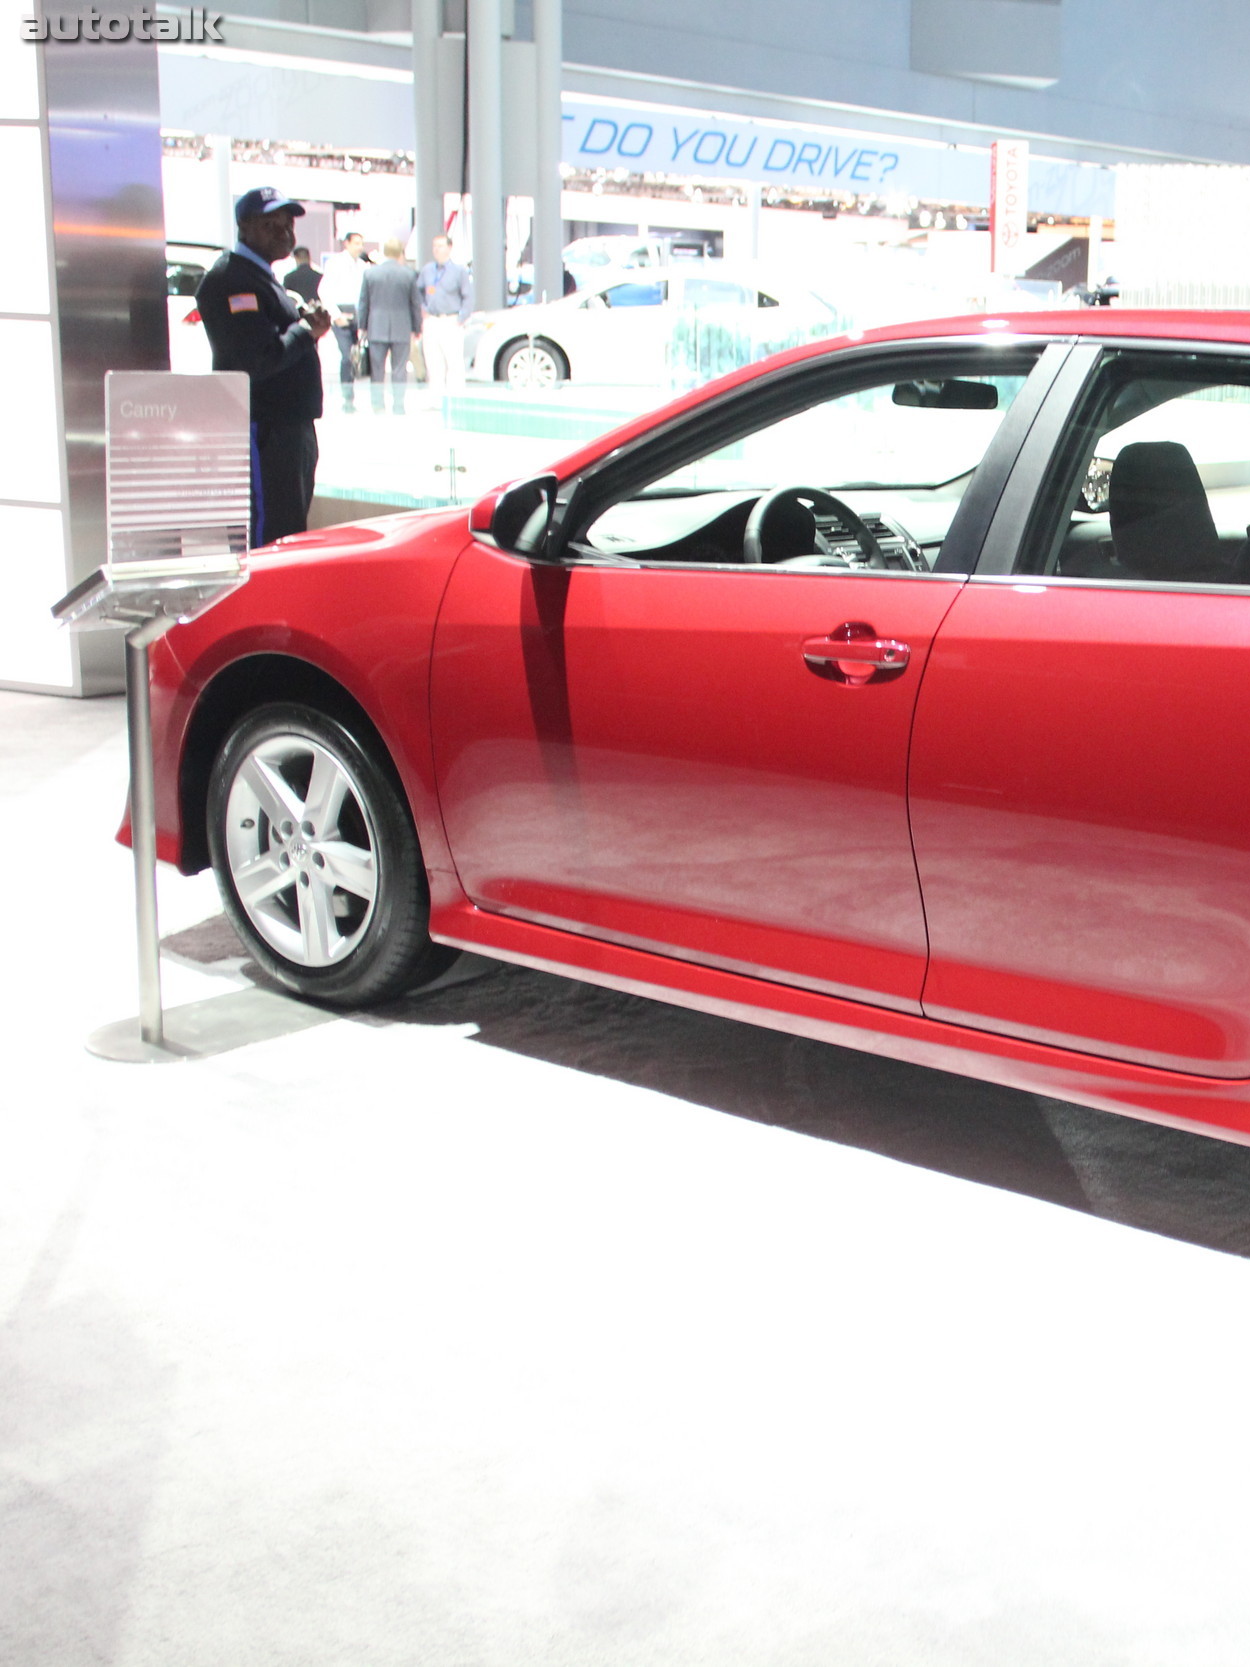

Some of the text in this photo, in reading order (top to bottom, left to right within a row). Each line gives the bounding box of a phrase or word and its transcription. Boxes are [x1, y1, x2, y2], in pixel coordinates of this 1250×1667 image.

[579, 117, 899, 183] DO YOU DRIVE?
[1005, 147, 1018, 217] TOYOTA
[120, 401, 178, 422] Camry
